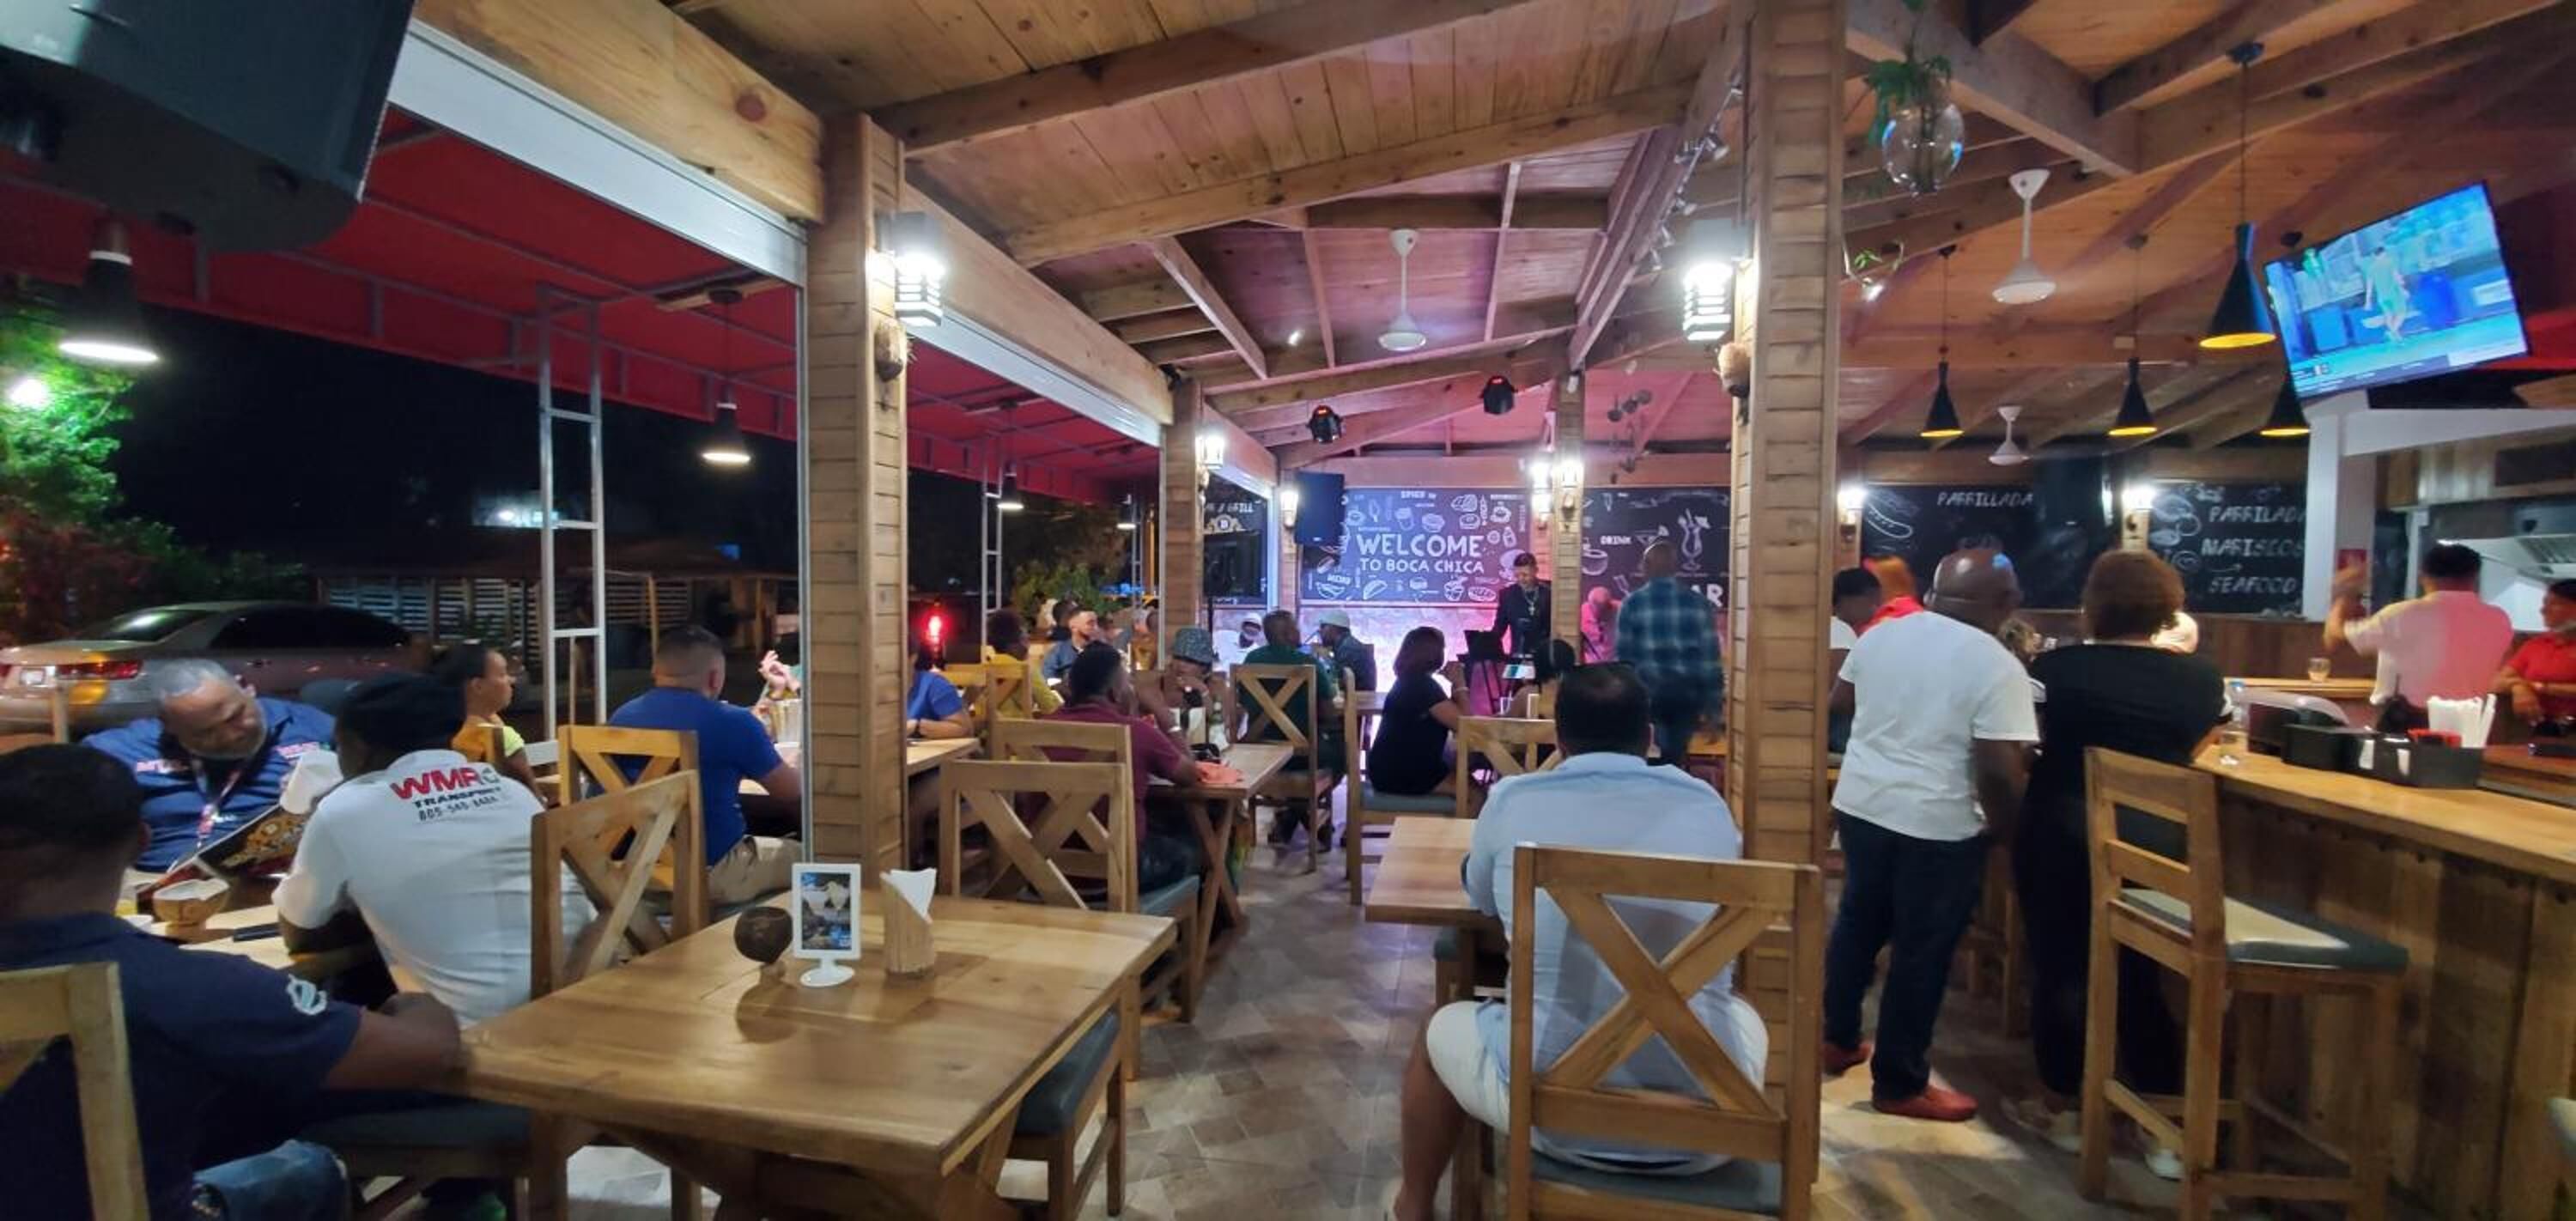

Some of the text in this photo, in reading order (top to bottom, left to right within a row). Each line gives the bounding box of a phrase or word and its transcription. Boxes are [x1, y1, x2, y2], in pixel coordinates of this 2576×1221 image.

[1357, 533, 1484, 557] WELCOME
[1360, 558, 1484, 574] TO BOCA CHICA
[2208, 576, 2296, 594] SEAFOOD
